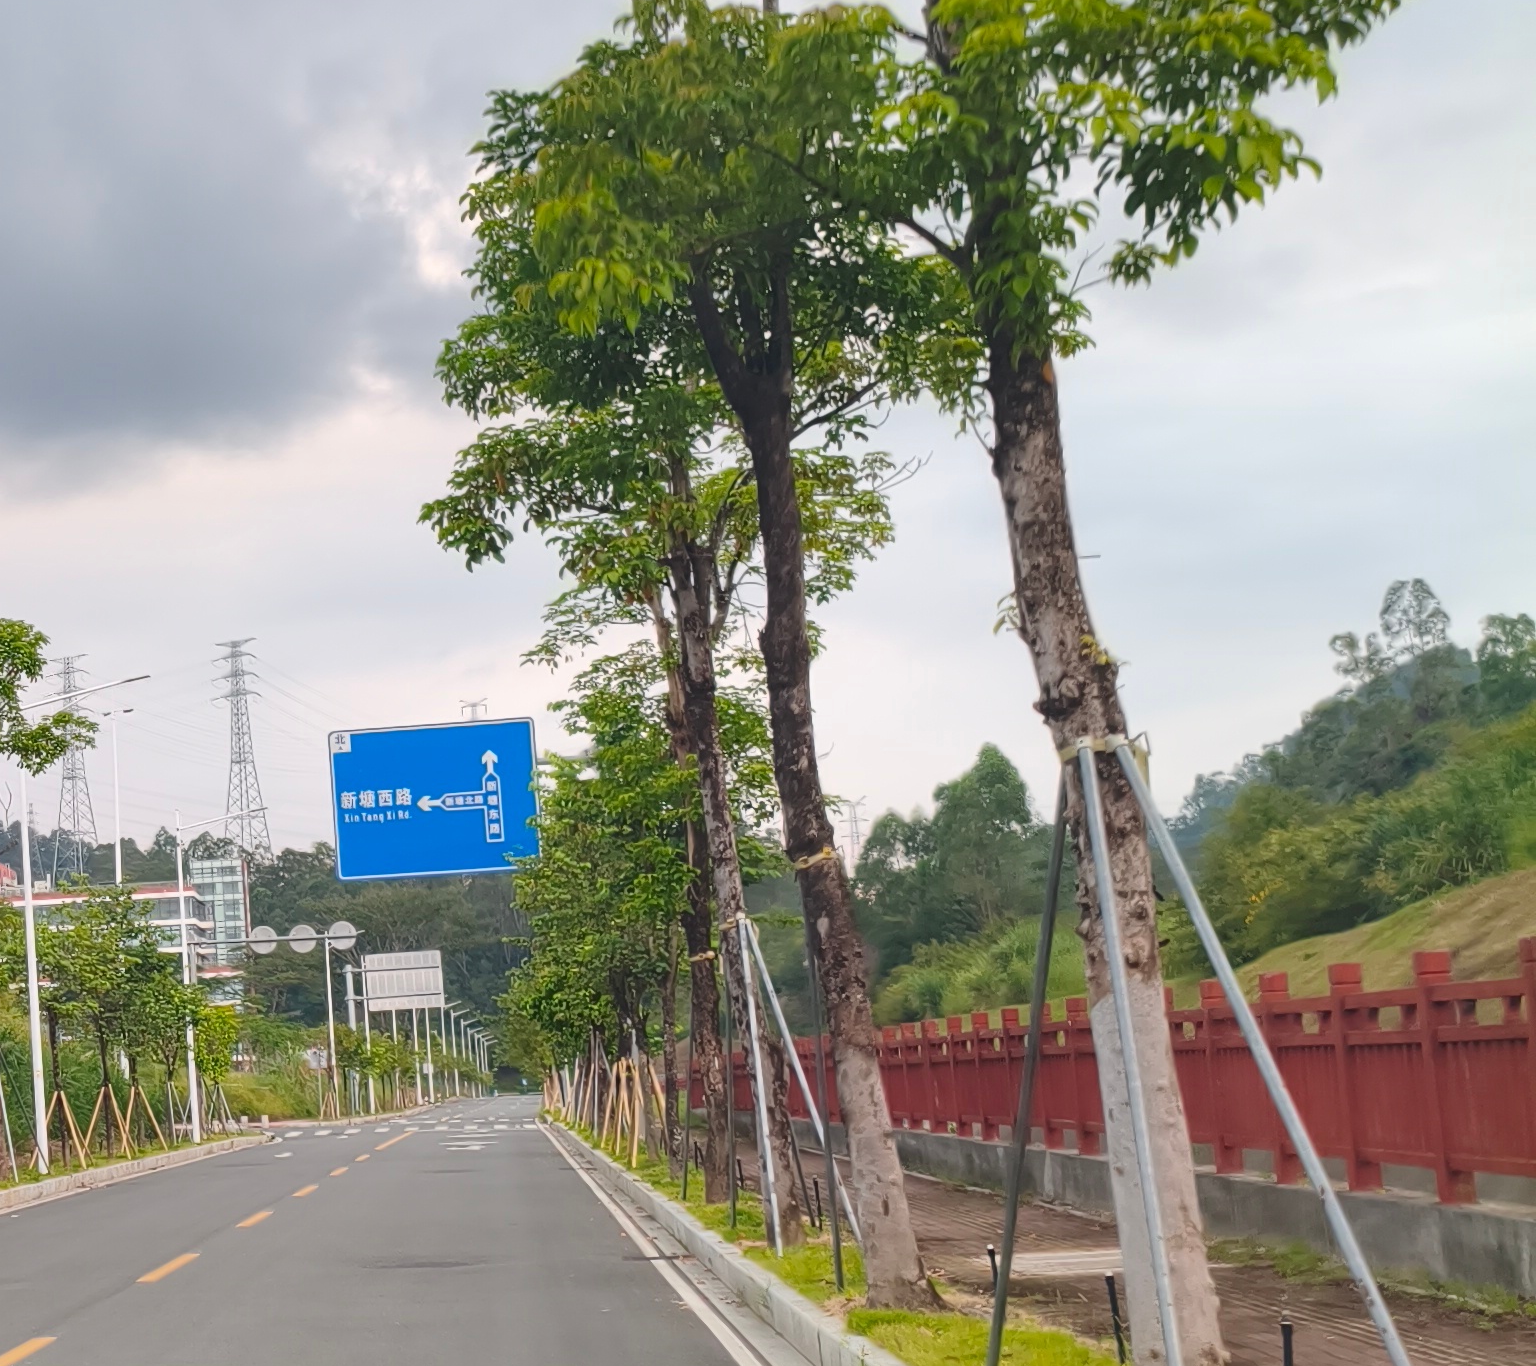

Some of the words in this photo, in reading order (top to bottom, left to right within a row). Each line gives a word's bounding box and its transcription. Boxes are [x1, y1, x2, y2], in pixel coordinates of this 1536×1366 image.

[335, 734, 345, 744] 北
[340, 788, 412, 809] 新塘西路
[344, 813, 360, 823] Xin
[361, 812, 384, 824] Tang
[386, 810, 396, 821] Xi
[398, 810, 413, 820] Rd.
